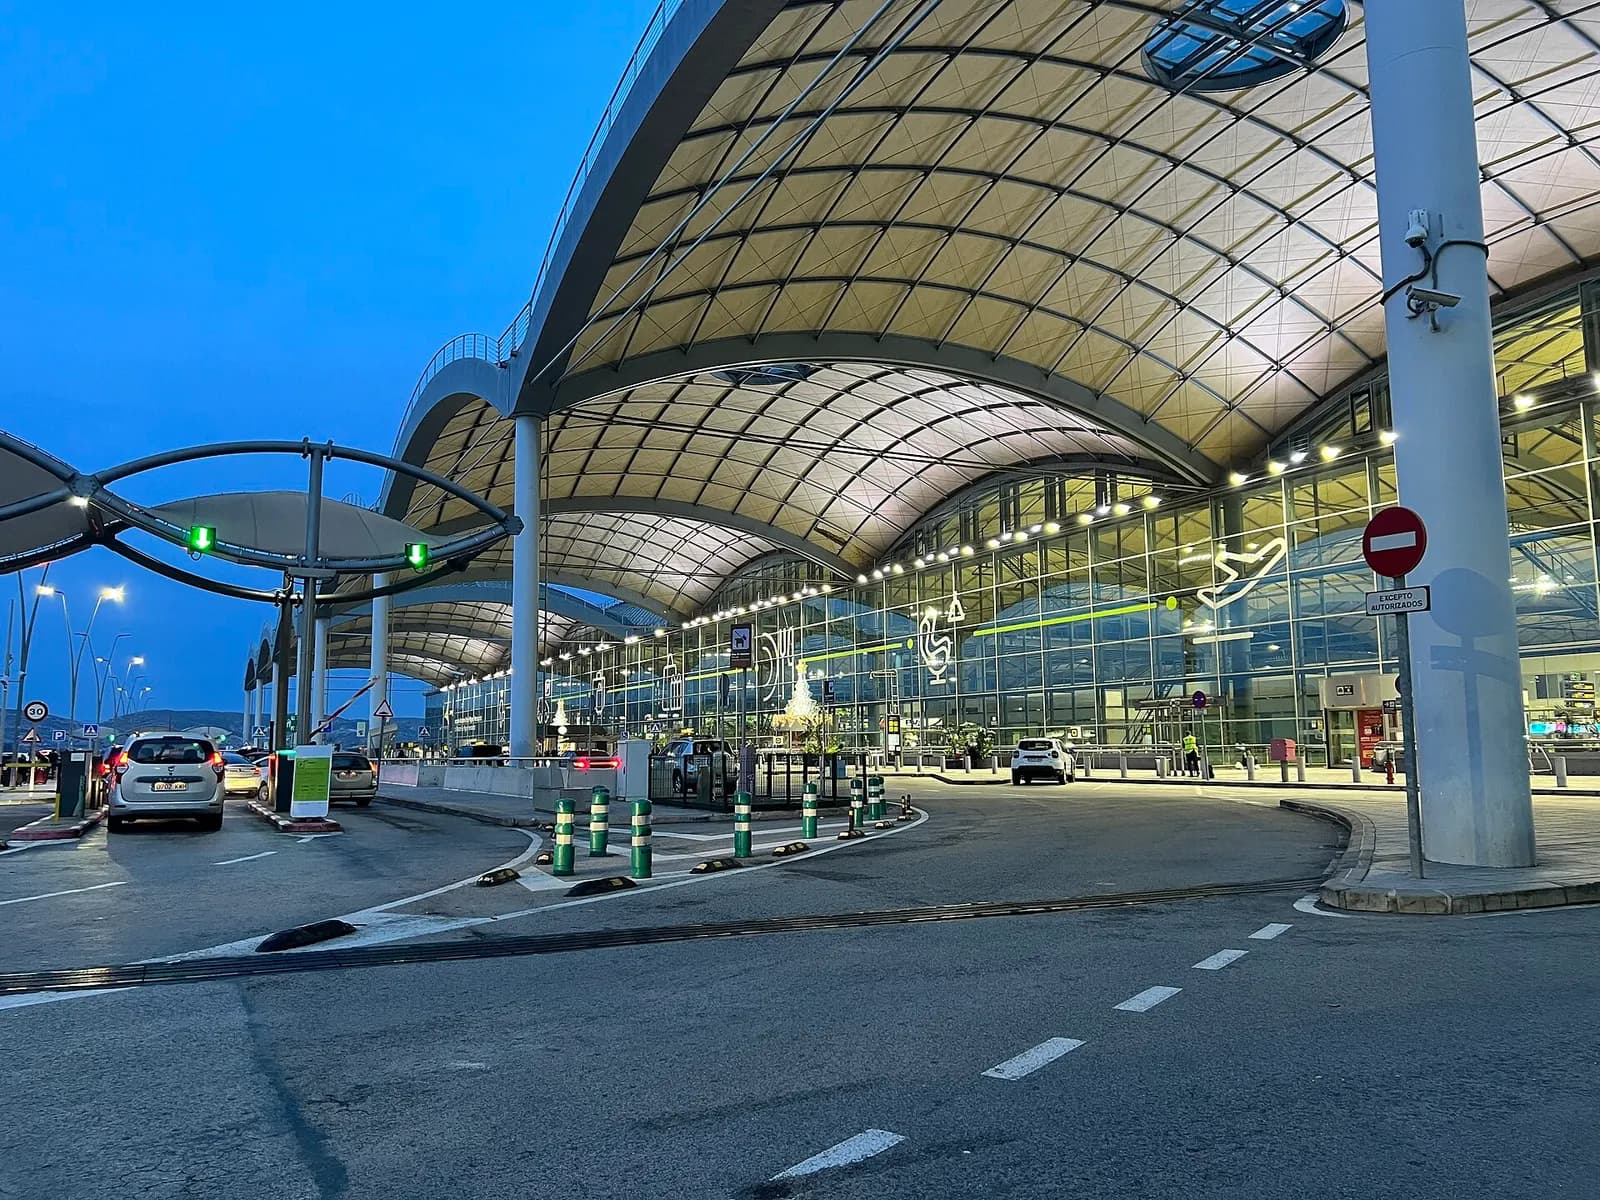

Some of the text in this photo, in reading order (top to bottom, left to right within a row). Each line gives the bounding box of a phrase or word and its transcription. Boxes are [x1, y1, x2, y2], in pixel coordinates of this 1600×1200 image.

[1379, 592, 1413, 602] EXCEPTO
[1371, 600, 1423, 611] AUTORIZADOS
[29, 708, 44, 716] 30
[55, 731, 63, 740] P
